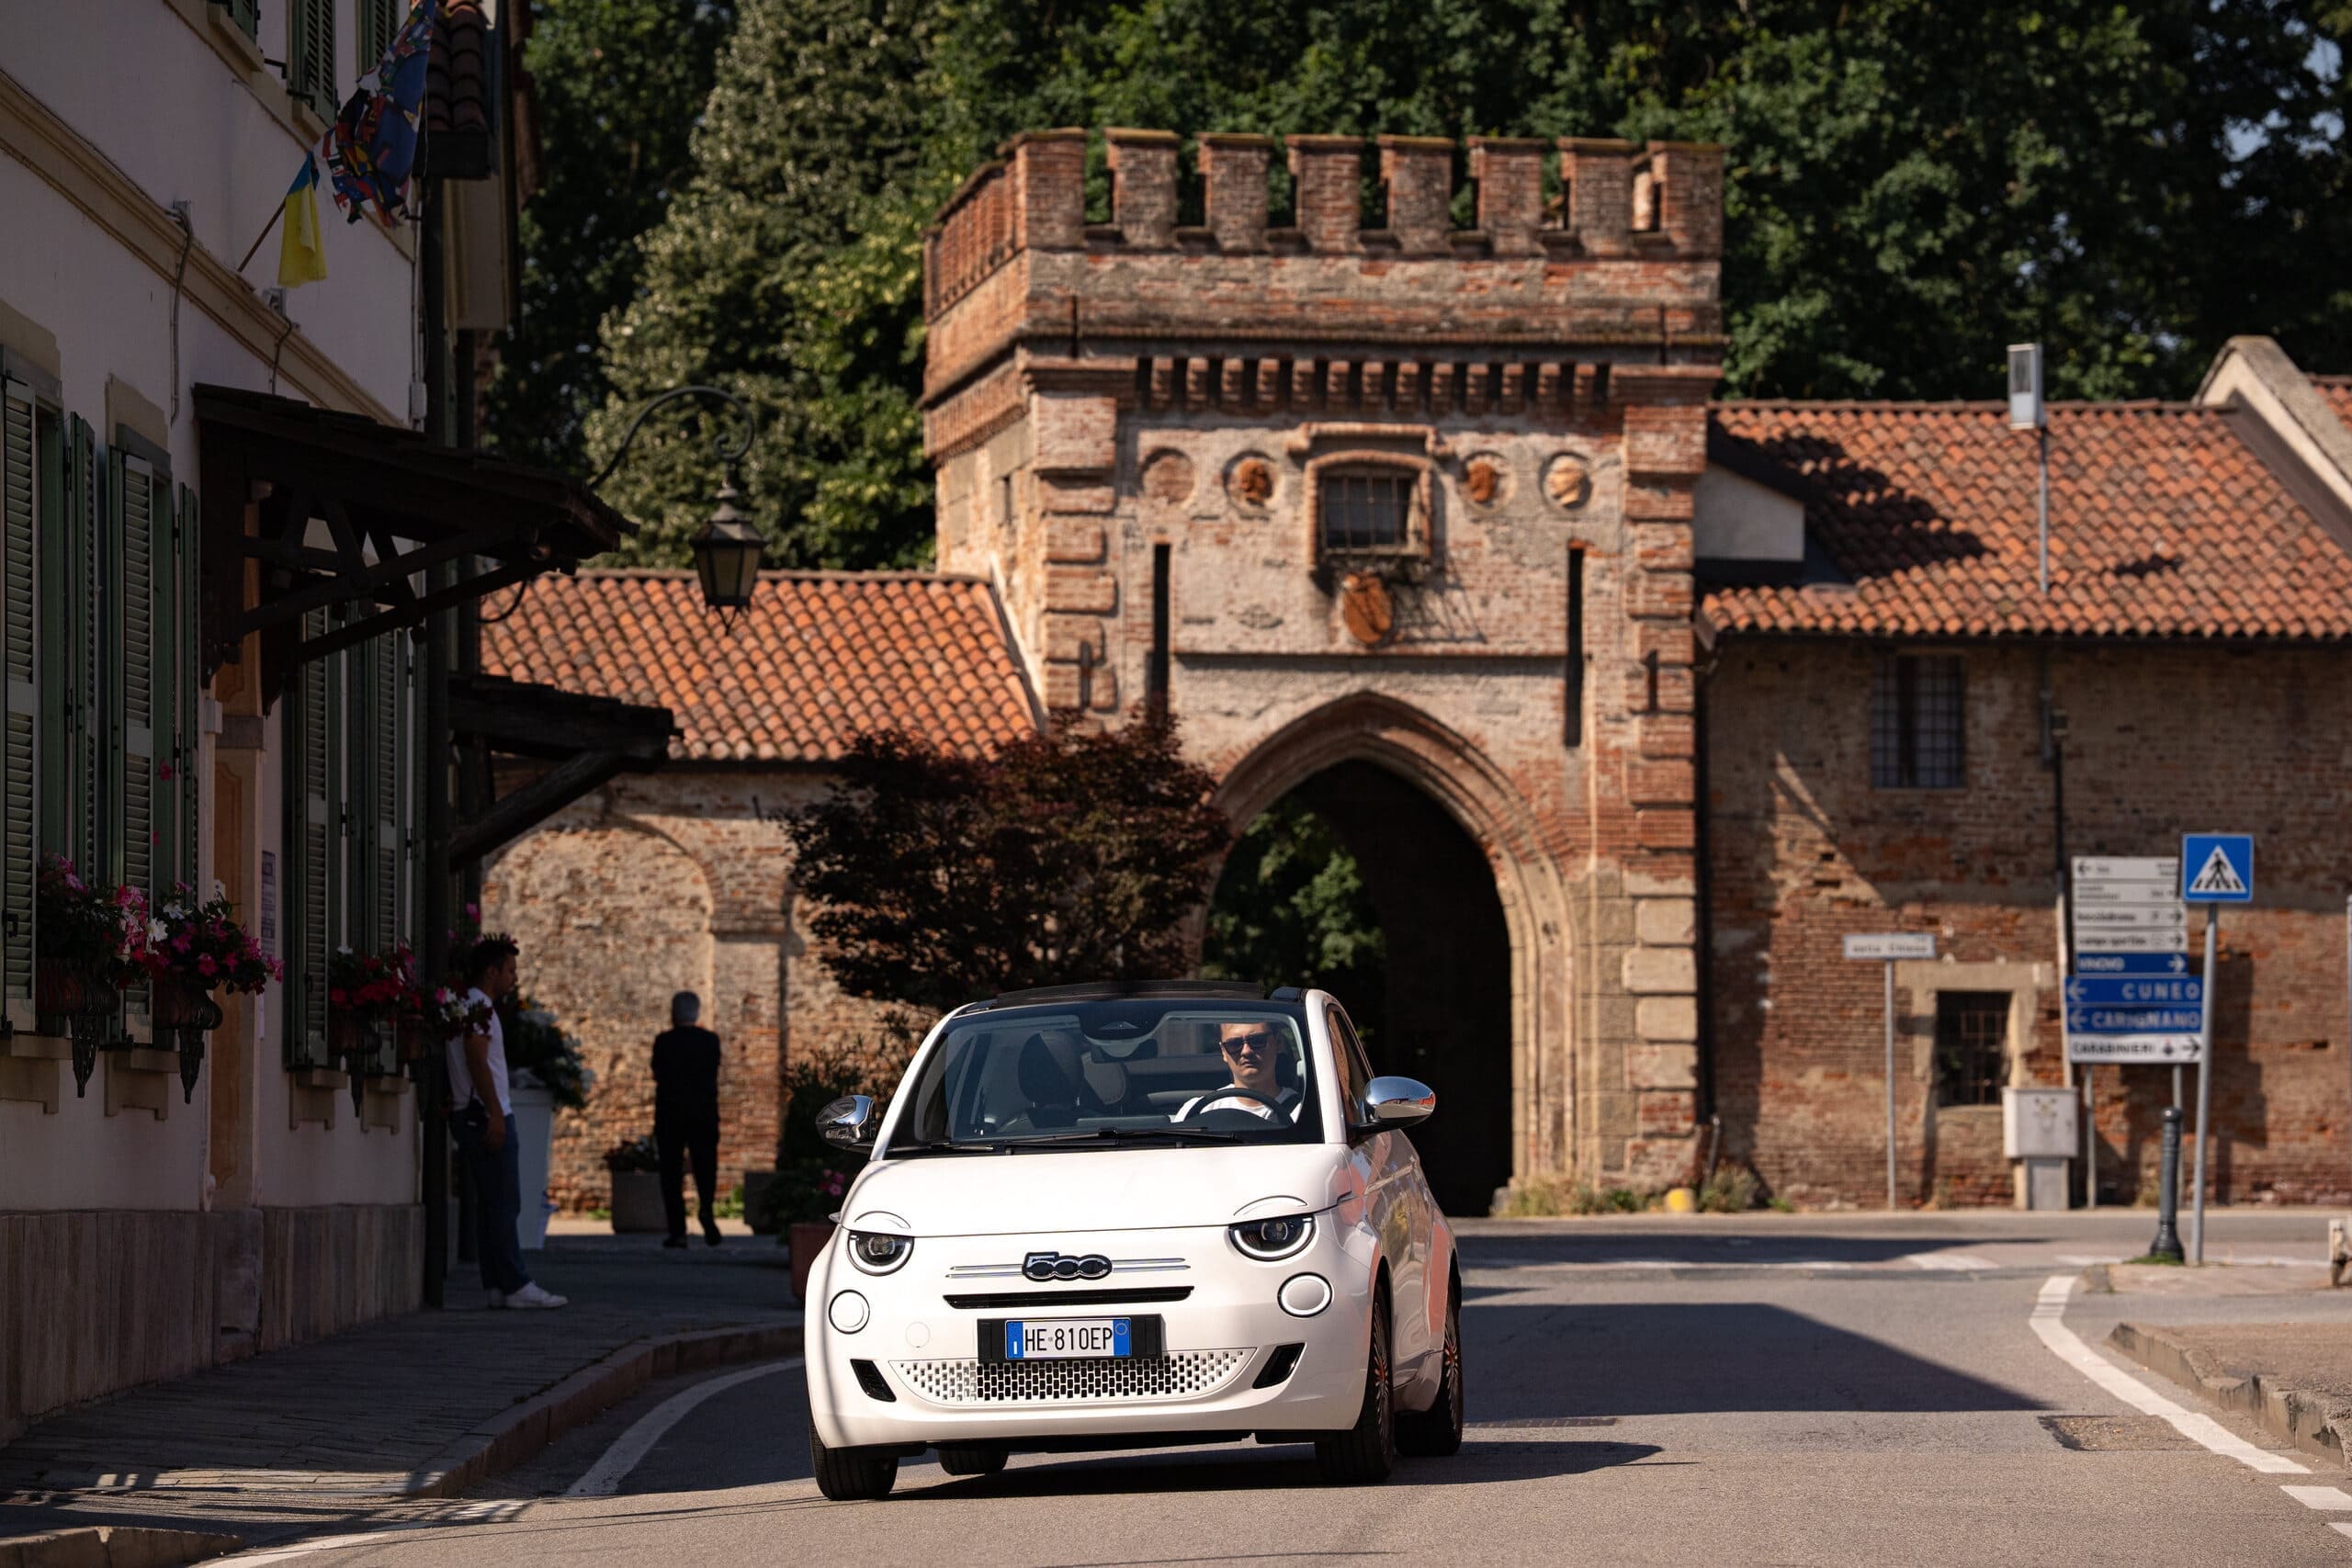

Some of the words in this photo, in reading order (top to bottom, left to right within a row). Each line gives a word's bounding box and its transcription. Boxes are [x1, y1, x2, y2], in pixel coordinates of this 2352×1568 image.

[2121, 982, 2200, 1000] CUNEO
[2091, 1011, 2200, 1029] CARIGNANO
[2073, 1042, 2155, 1054] CARABINIERI
[1023, 1253, 1110, 1280] 500
[1024, 1328, 1047, 1351] HE
[1054, 1326, 1114, 1351] 810EP
